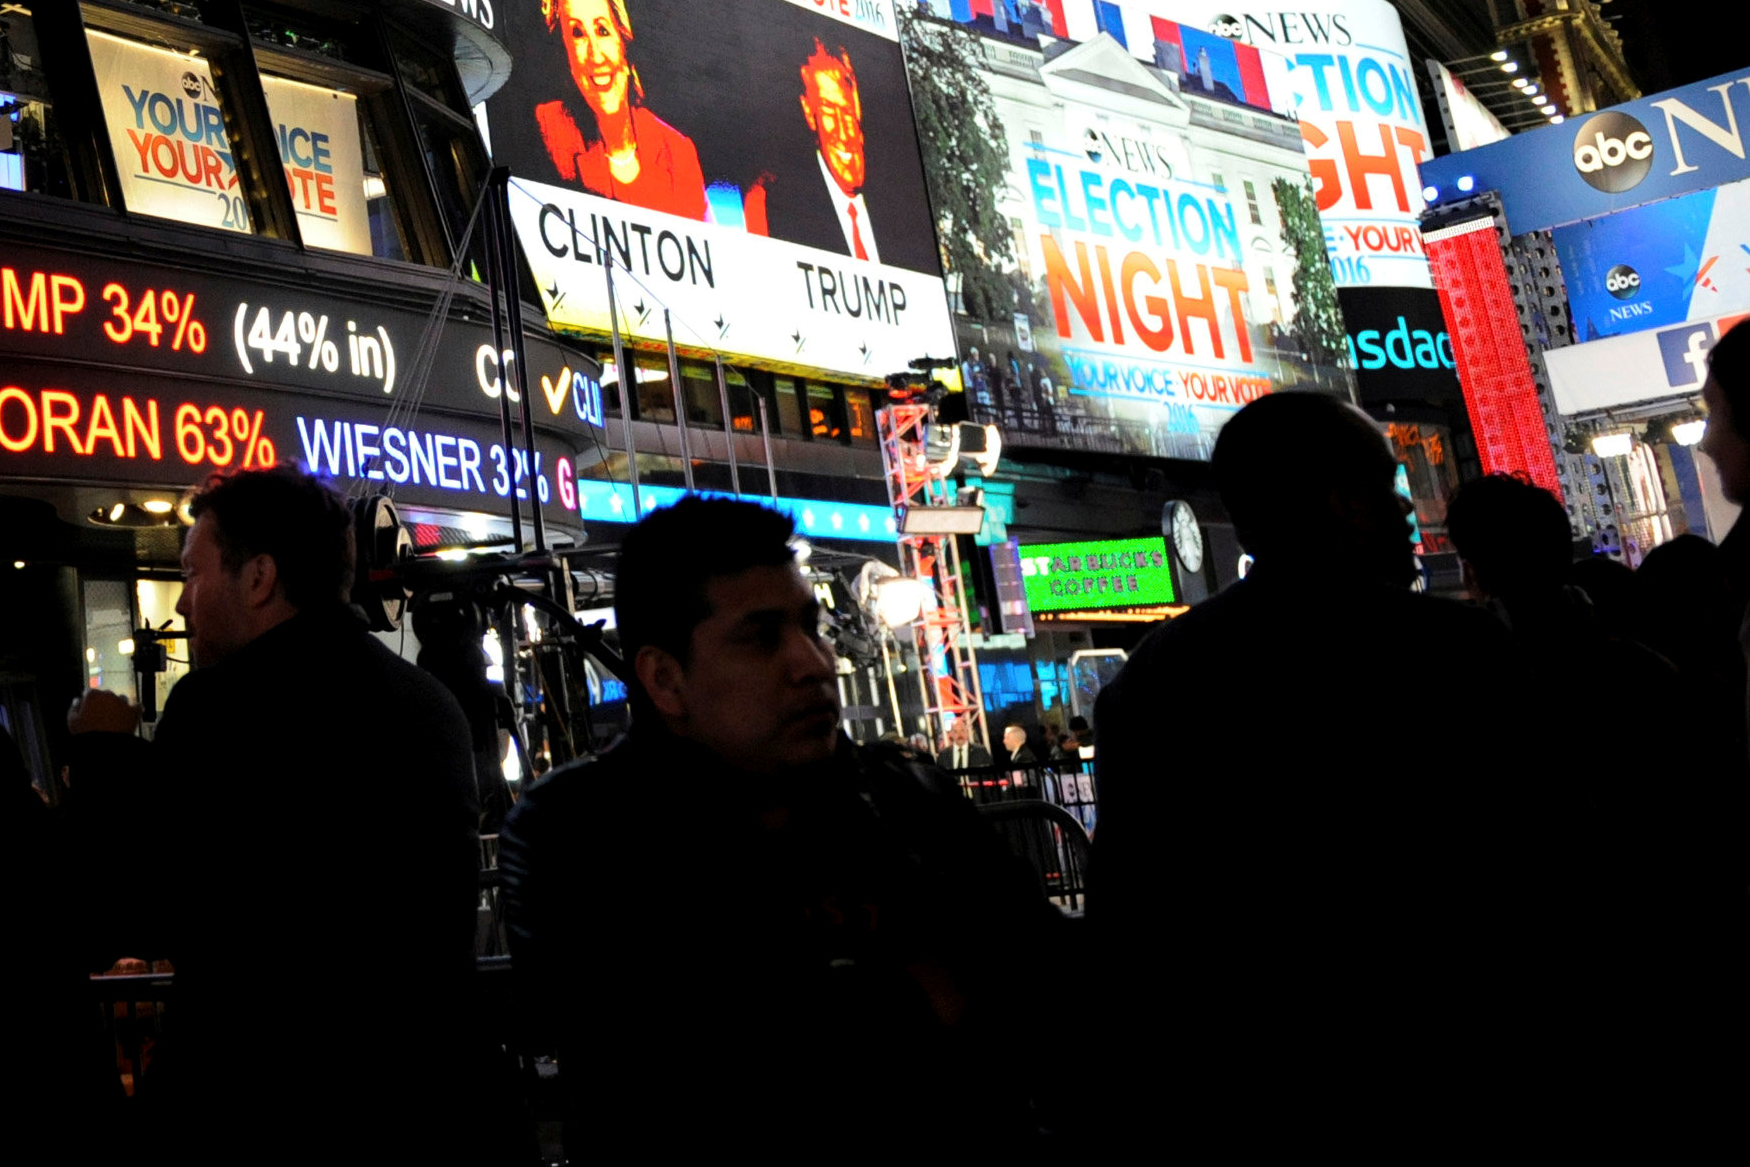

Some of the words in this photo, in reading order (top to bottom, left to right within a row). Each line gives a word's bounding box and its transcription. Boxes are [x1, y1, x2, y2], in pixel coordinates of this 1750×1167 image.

[1241, 12, 1352, 47] NEWS
[121, 84, 228, 149] YOUR
[275, 123, 333, 174] ICE
[1573, 126, 1653, 174] abc
[126, 128, 226, 190] YOUR
[1299, 119, 1427, 214] GHT
[217, 192, 248, 231] 20
[1025, 157, 1244, 264] ELECTION
[538, 201, 716, 289] CLINTON
[796, 260, 908, 326] TRUMP
[1344, 224, 1413, 253] YOUR
[1332, 256, 1371, 286] 016
[1040, 234, 1253, 364] NIGHT
[1609, 300, 1653, 322] NEWS
[101, 282, 206, 355] 34%
[233, 301, 339, 375] (44%
[348, 319, 396, 394] in)
[1063, 353, 1118, 391] YOUR
[1117, 362, 1176, 397] VOICE
[1178, 370, 1229, 403] YOUR
[174, 402, 275, 469] 63%
[295, 414, 486, 494] WIESNER
[1019, 551, 1163, 576] STARBUCKS
[1050, 575, 1139, 596] COFFEE
